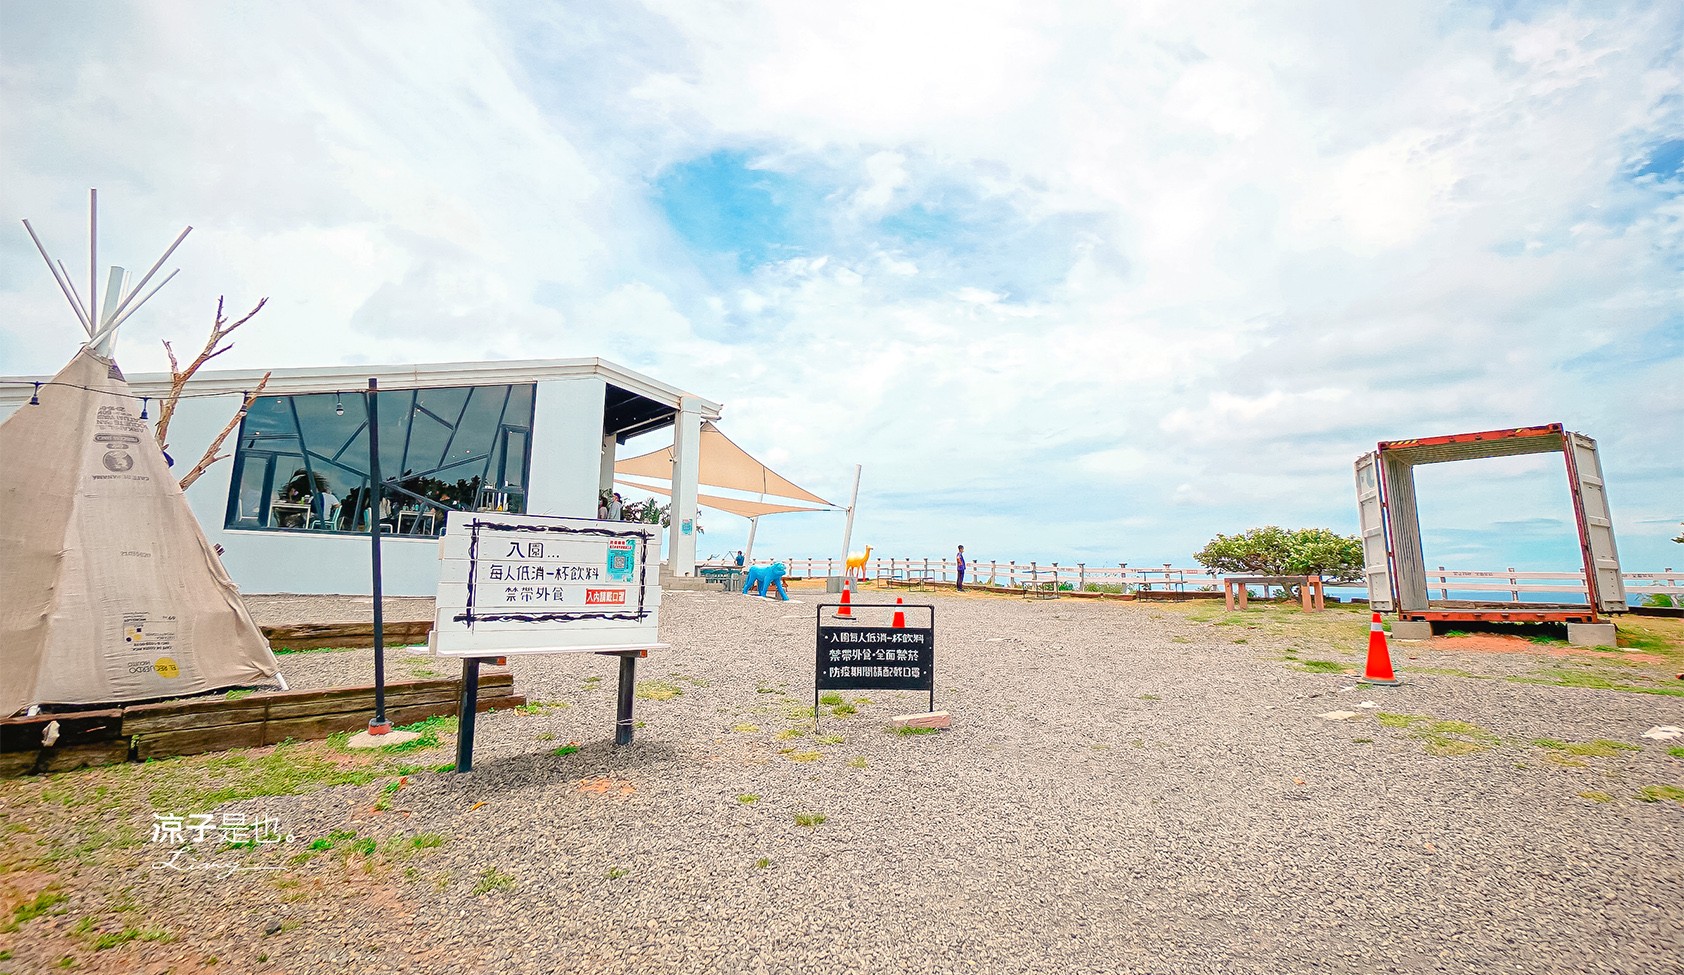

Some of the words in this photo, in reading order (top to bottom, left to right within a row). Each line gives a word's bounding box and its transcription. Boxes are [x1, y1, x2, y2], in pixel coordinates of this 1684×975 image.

[489, 564, 599, 581] 每人低消一杯飲料
[505, 586, 564, 602] 禁帶外食
